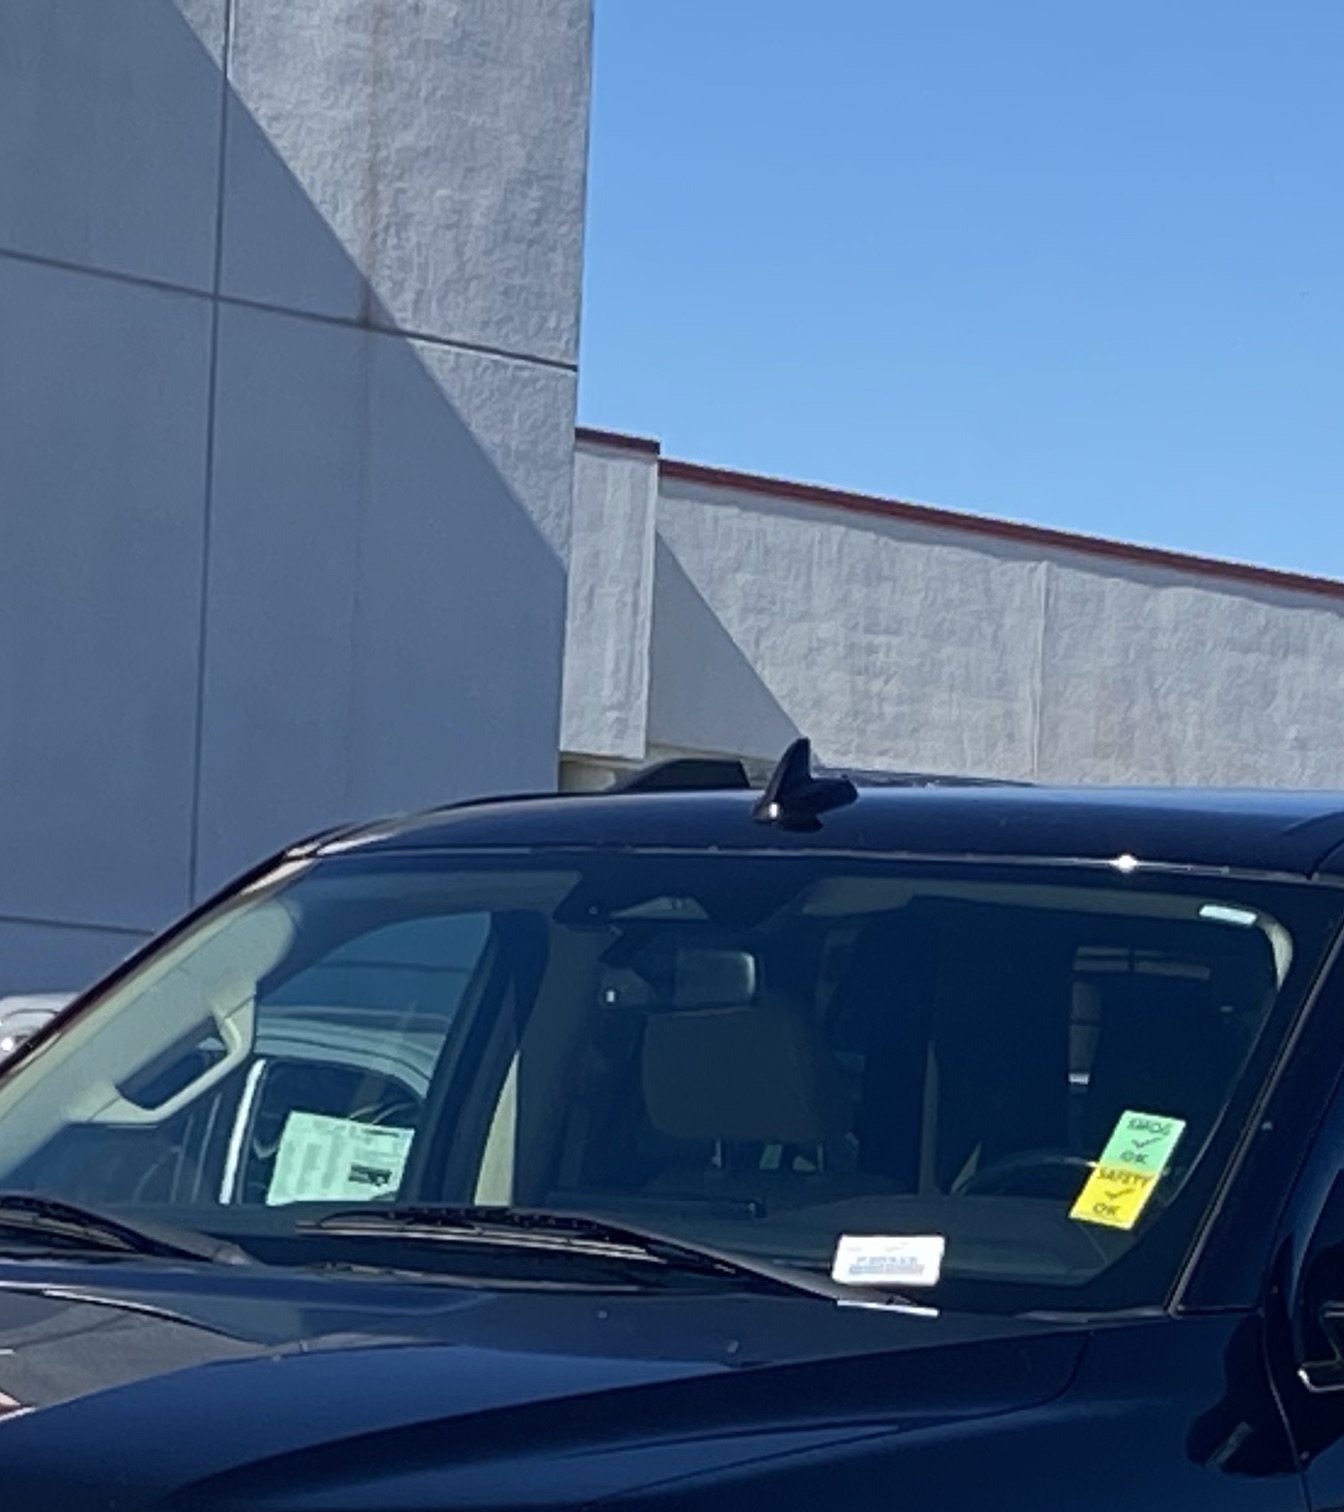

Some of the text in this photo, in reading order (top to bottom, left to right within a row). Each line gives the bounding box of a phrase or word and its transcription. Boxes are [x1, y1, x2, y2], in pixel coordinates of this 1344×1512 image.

[1119, 1150, 1148, 1165] OK
[1096, 1167, 1155, 1188] SAFETY
[1092, 1202, 1120, 1216] OK
